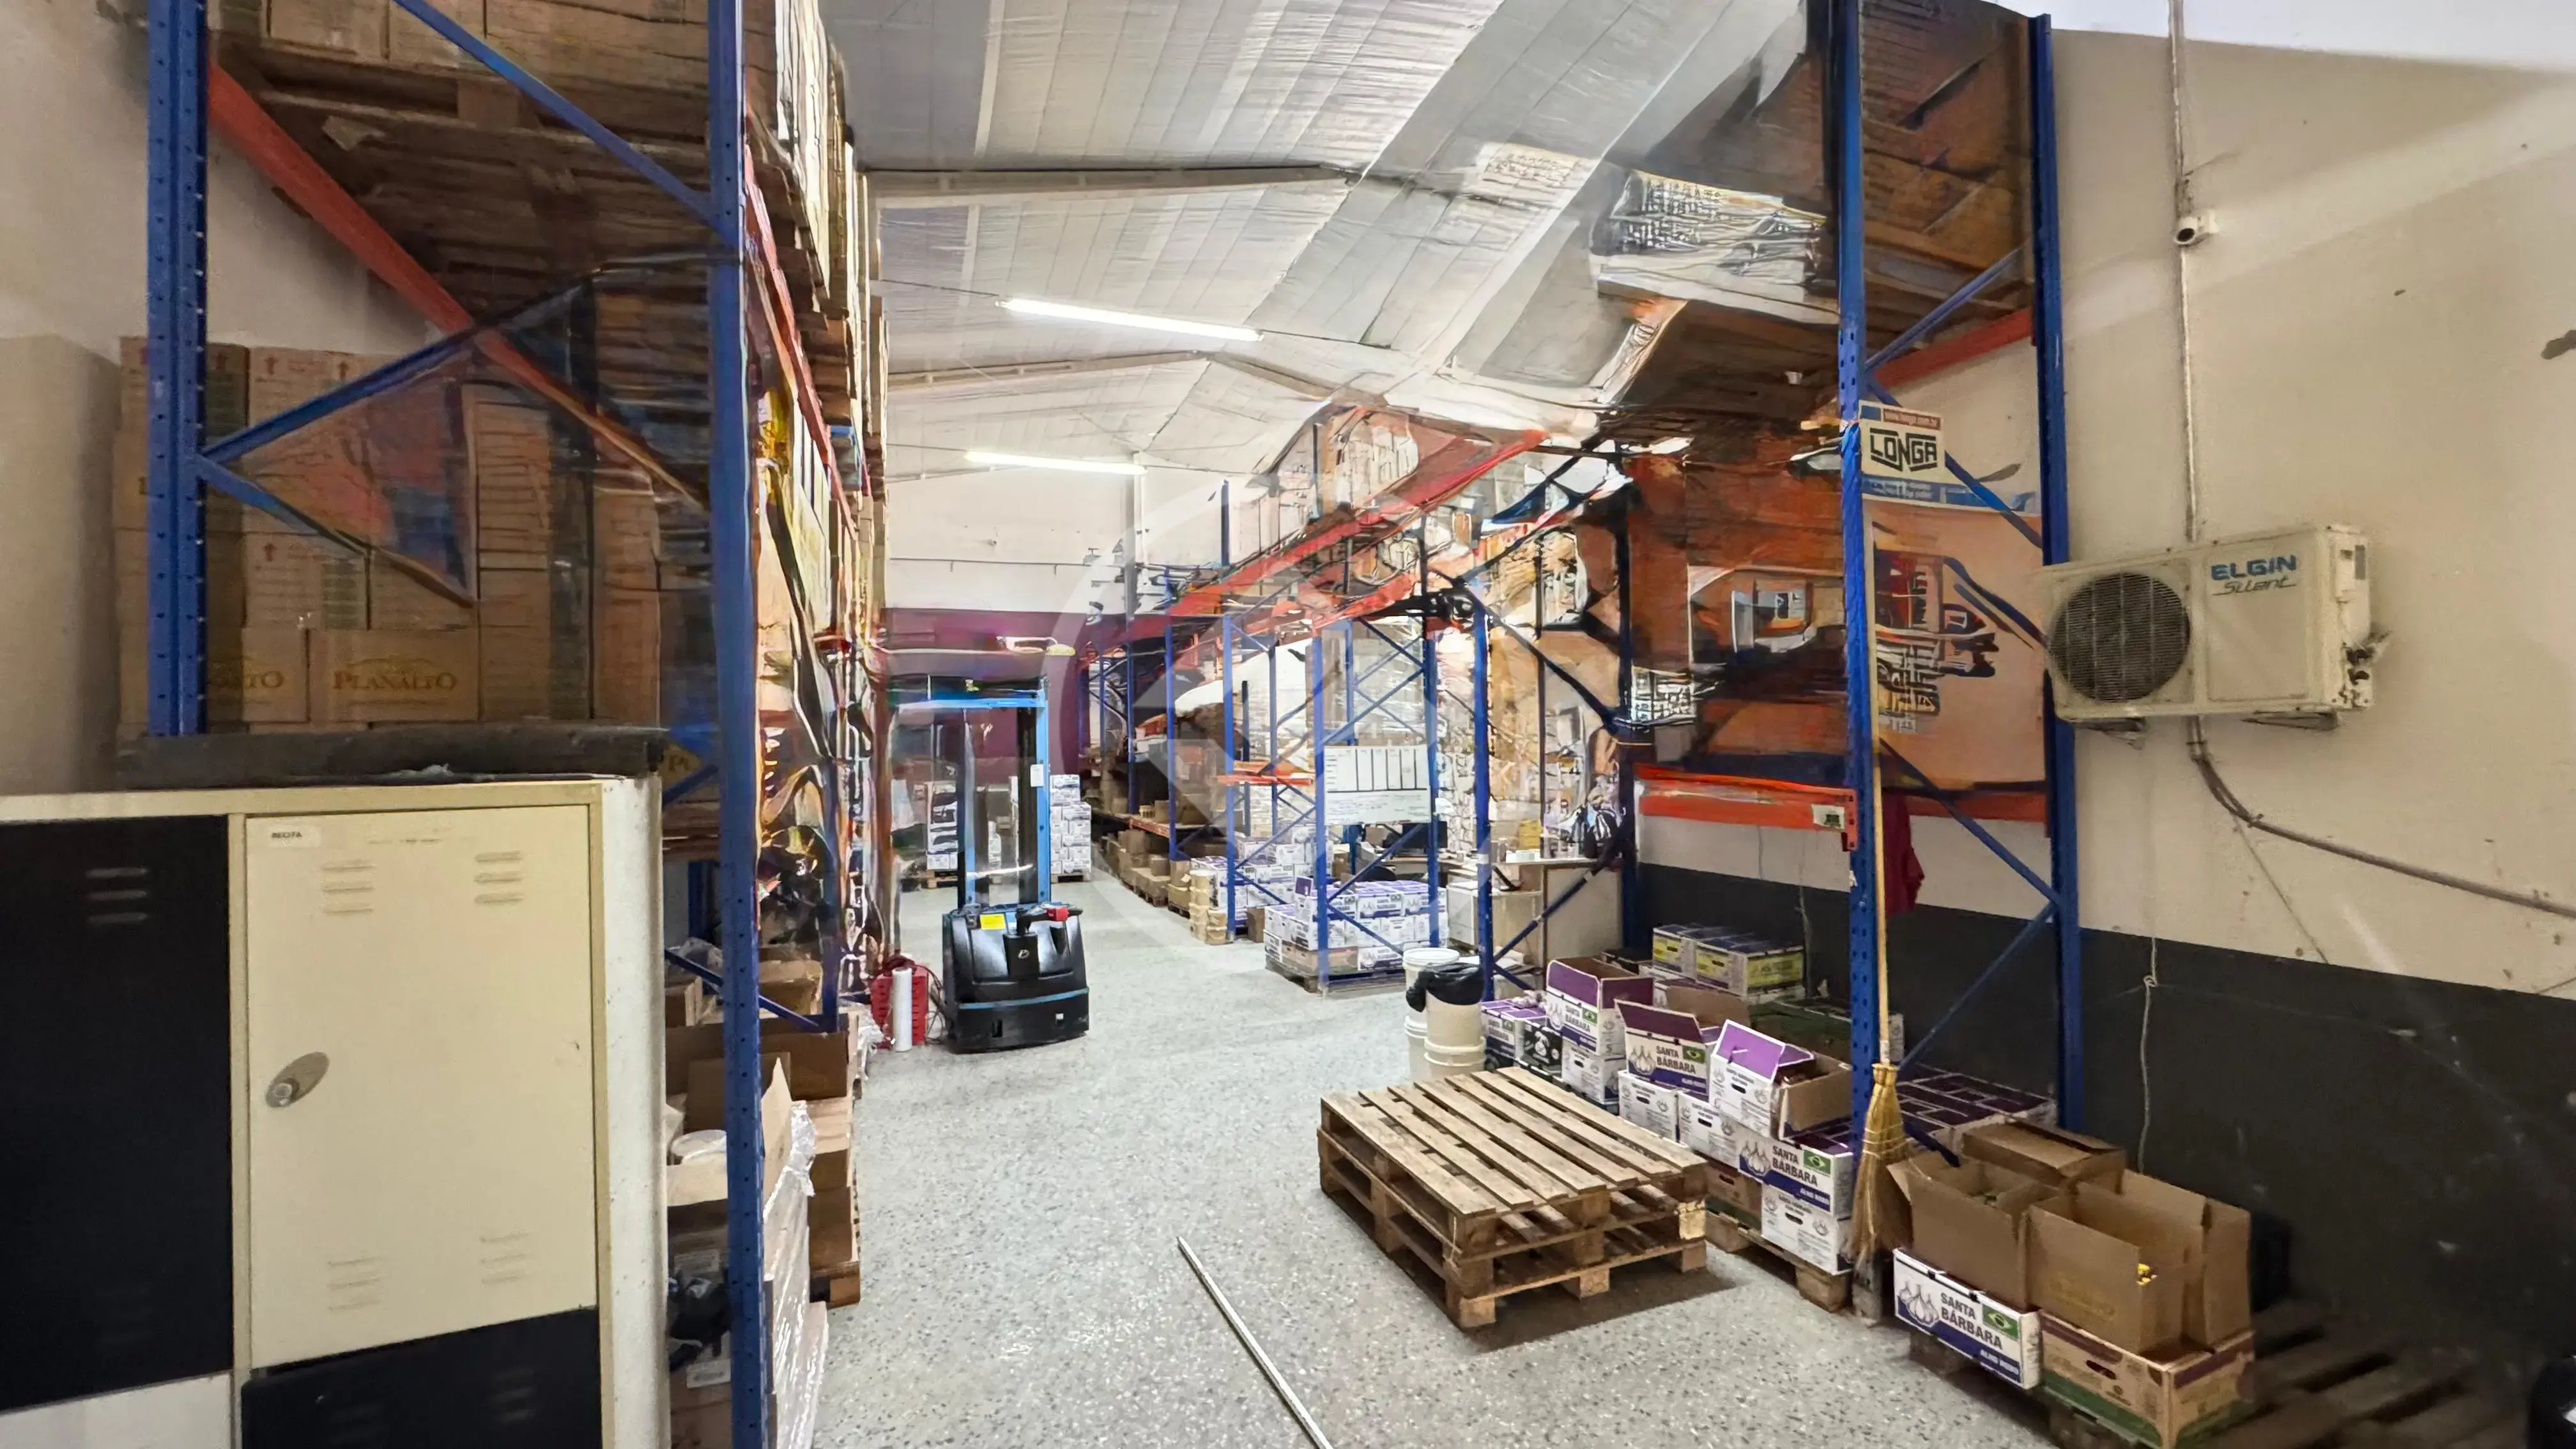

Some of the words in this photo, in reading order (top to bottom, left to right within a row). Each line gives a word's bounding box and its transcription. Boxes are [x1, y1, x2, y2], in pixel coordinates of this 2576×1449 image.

[1869, 427, 1938, 473] LONGA
[2211, 555, 2296, 581] ELGIN
[2212, 575, 2297, 595] Silent
[1655, 1045, 1680, 1059] SANTA
[1772, 1145, 1799, 1165] SANTA
[1940, 1292, 1976, 1320] SANTA
[1941, 1307, 2003, 1350] BÁRBARA
